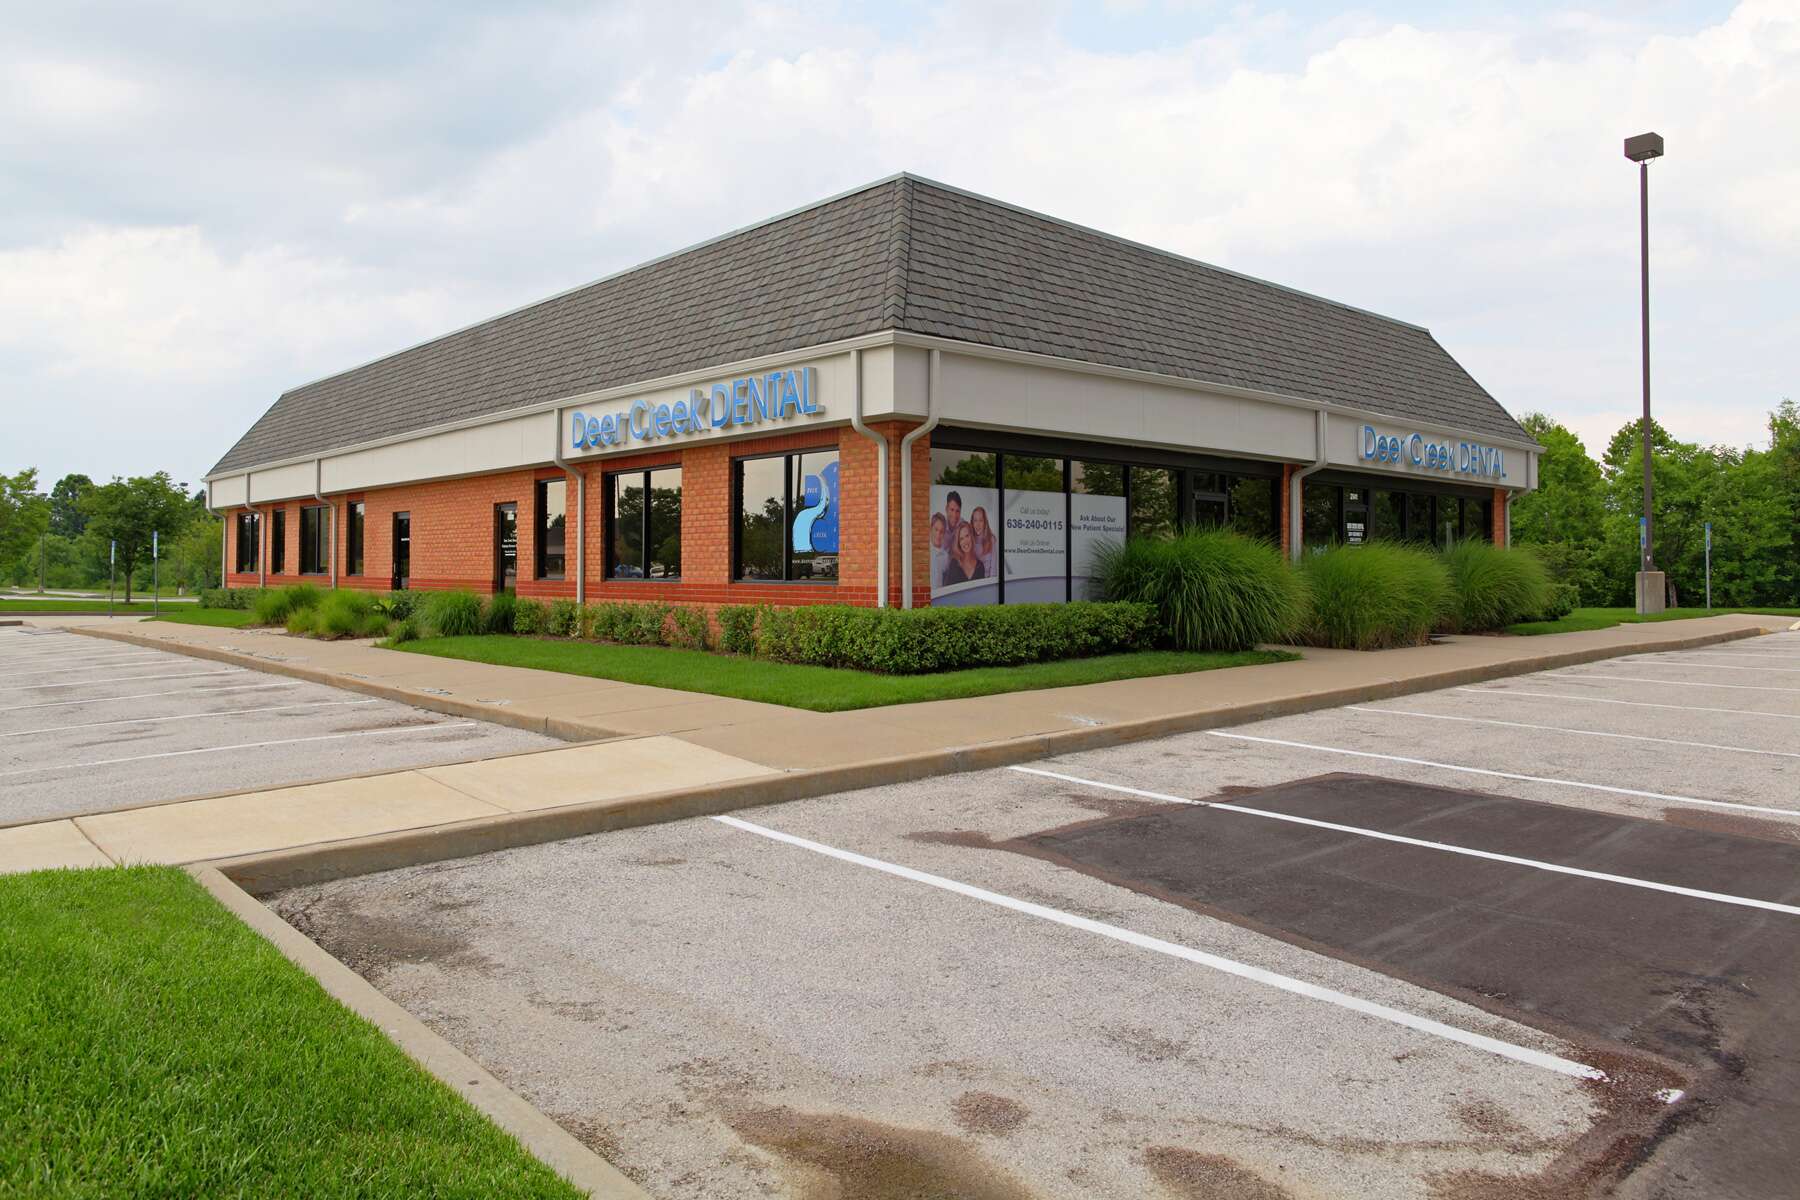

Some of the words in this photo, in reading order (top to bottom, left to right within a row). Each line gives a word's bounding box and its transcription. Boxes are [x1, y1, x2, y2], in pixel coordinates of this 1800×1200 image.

[572, 411, 628, 449] Deer
[628, 389, 711, 440] Creek
[711, 366, 825, 428] DENTAL
[1361, 424, 1405, 463] Deer
[1409, 432, 1456, 471] Creek
[1459, 440, 1507, 478] DENTAL
[1006, 518, 1063, 531] 636-240-0115
[1091, 514, 1105, 522] About
[1107, 515, 1116, 523] Our
[1083, 524, 1101, 532] Patient
